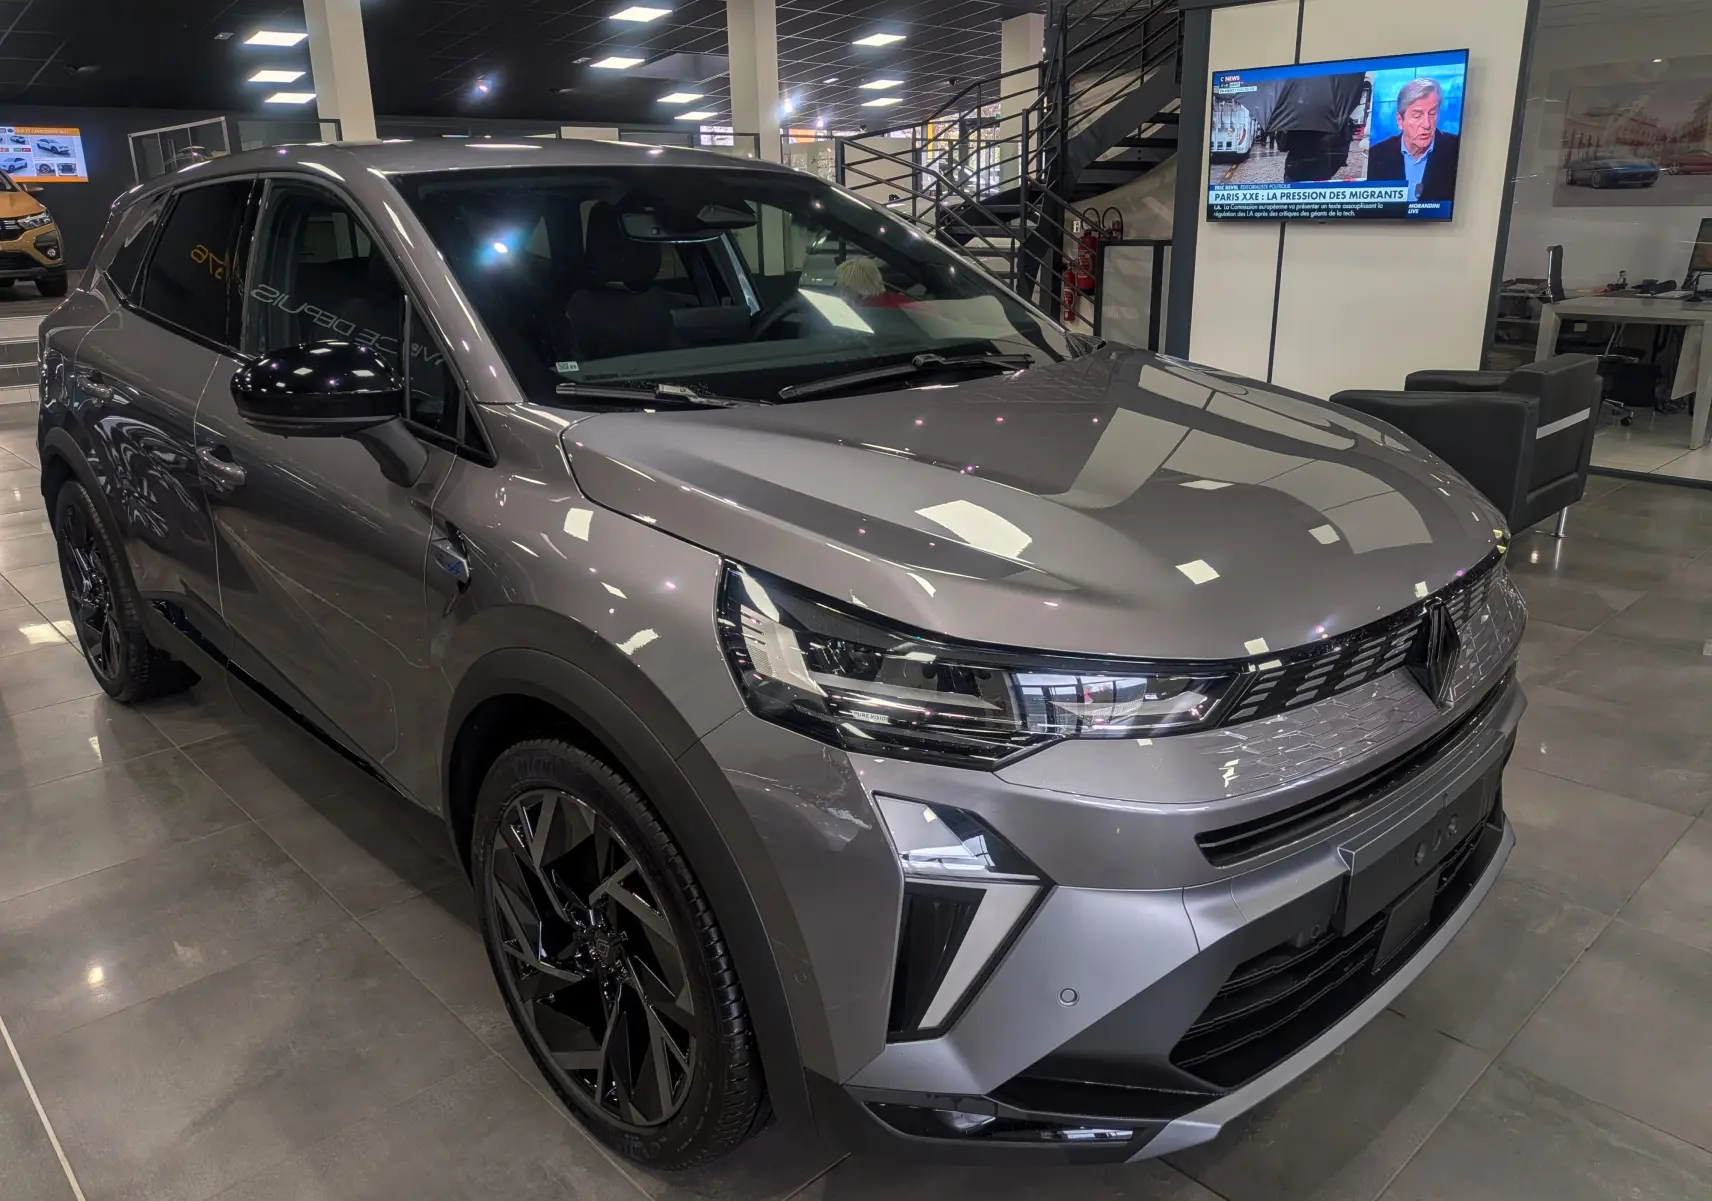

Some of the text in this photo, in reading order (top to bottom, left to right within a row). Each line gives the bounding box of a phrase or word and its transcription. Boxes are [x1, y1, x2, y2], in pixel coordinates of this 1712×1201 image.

[1214, 193, 1240, 201] PARIS
[1242, 192, 1260, 201] XXE
[1267, 192, 1278, 200] LA
[1280, 191, 1326, 200] PRESSION
[1329, 191, 1346, 200] DES
[1348, 190, 1404, 200] MIGRANTS
